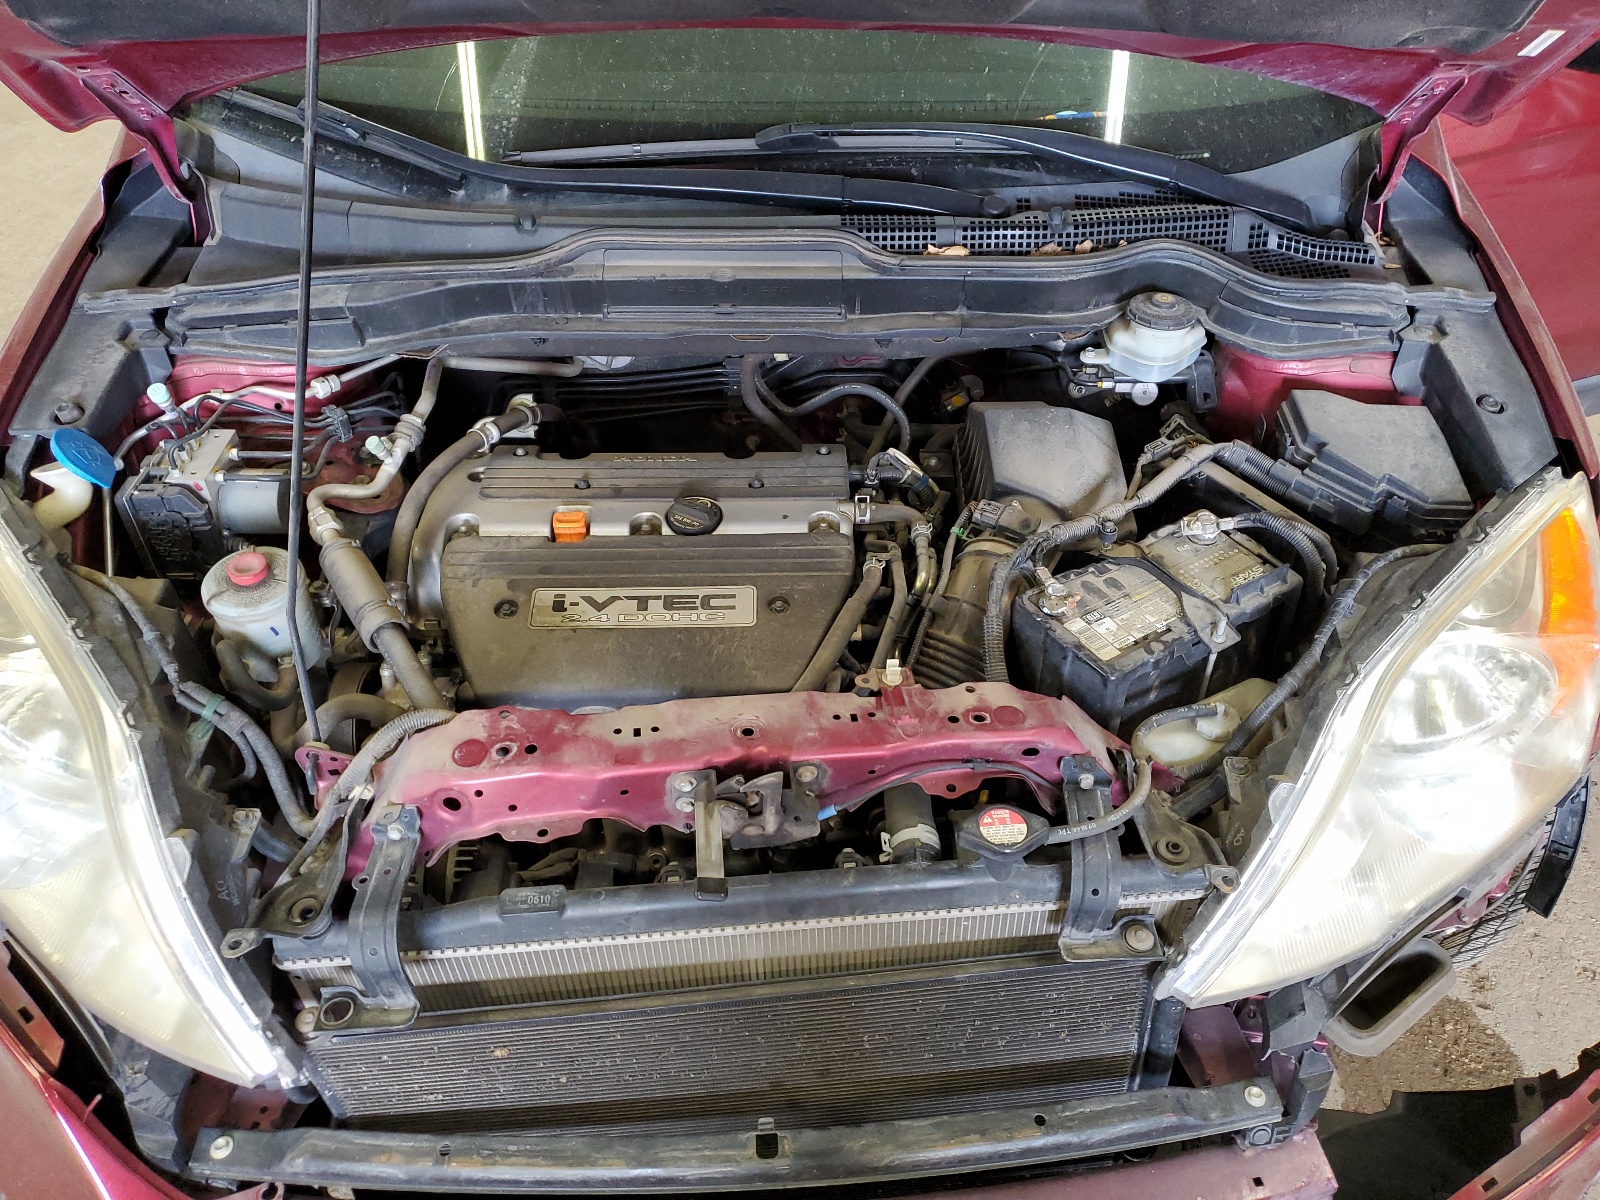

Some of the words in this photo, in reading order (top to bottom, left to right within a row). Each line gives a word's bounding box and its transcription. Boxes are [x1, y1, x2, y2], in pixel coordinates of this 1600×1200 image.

[667, 285, 717, 295] FRAME
[724, 285, 790, 296] NUMBER
[1231, 565, 1264, 583] START
[551, 593, 737, 613] i-VTEC
[561, 613, 611, 623] 2.4
[617, 612, 726, 623] DOHC
